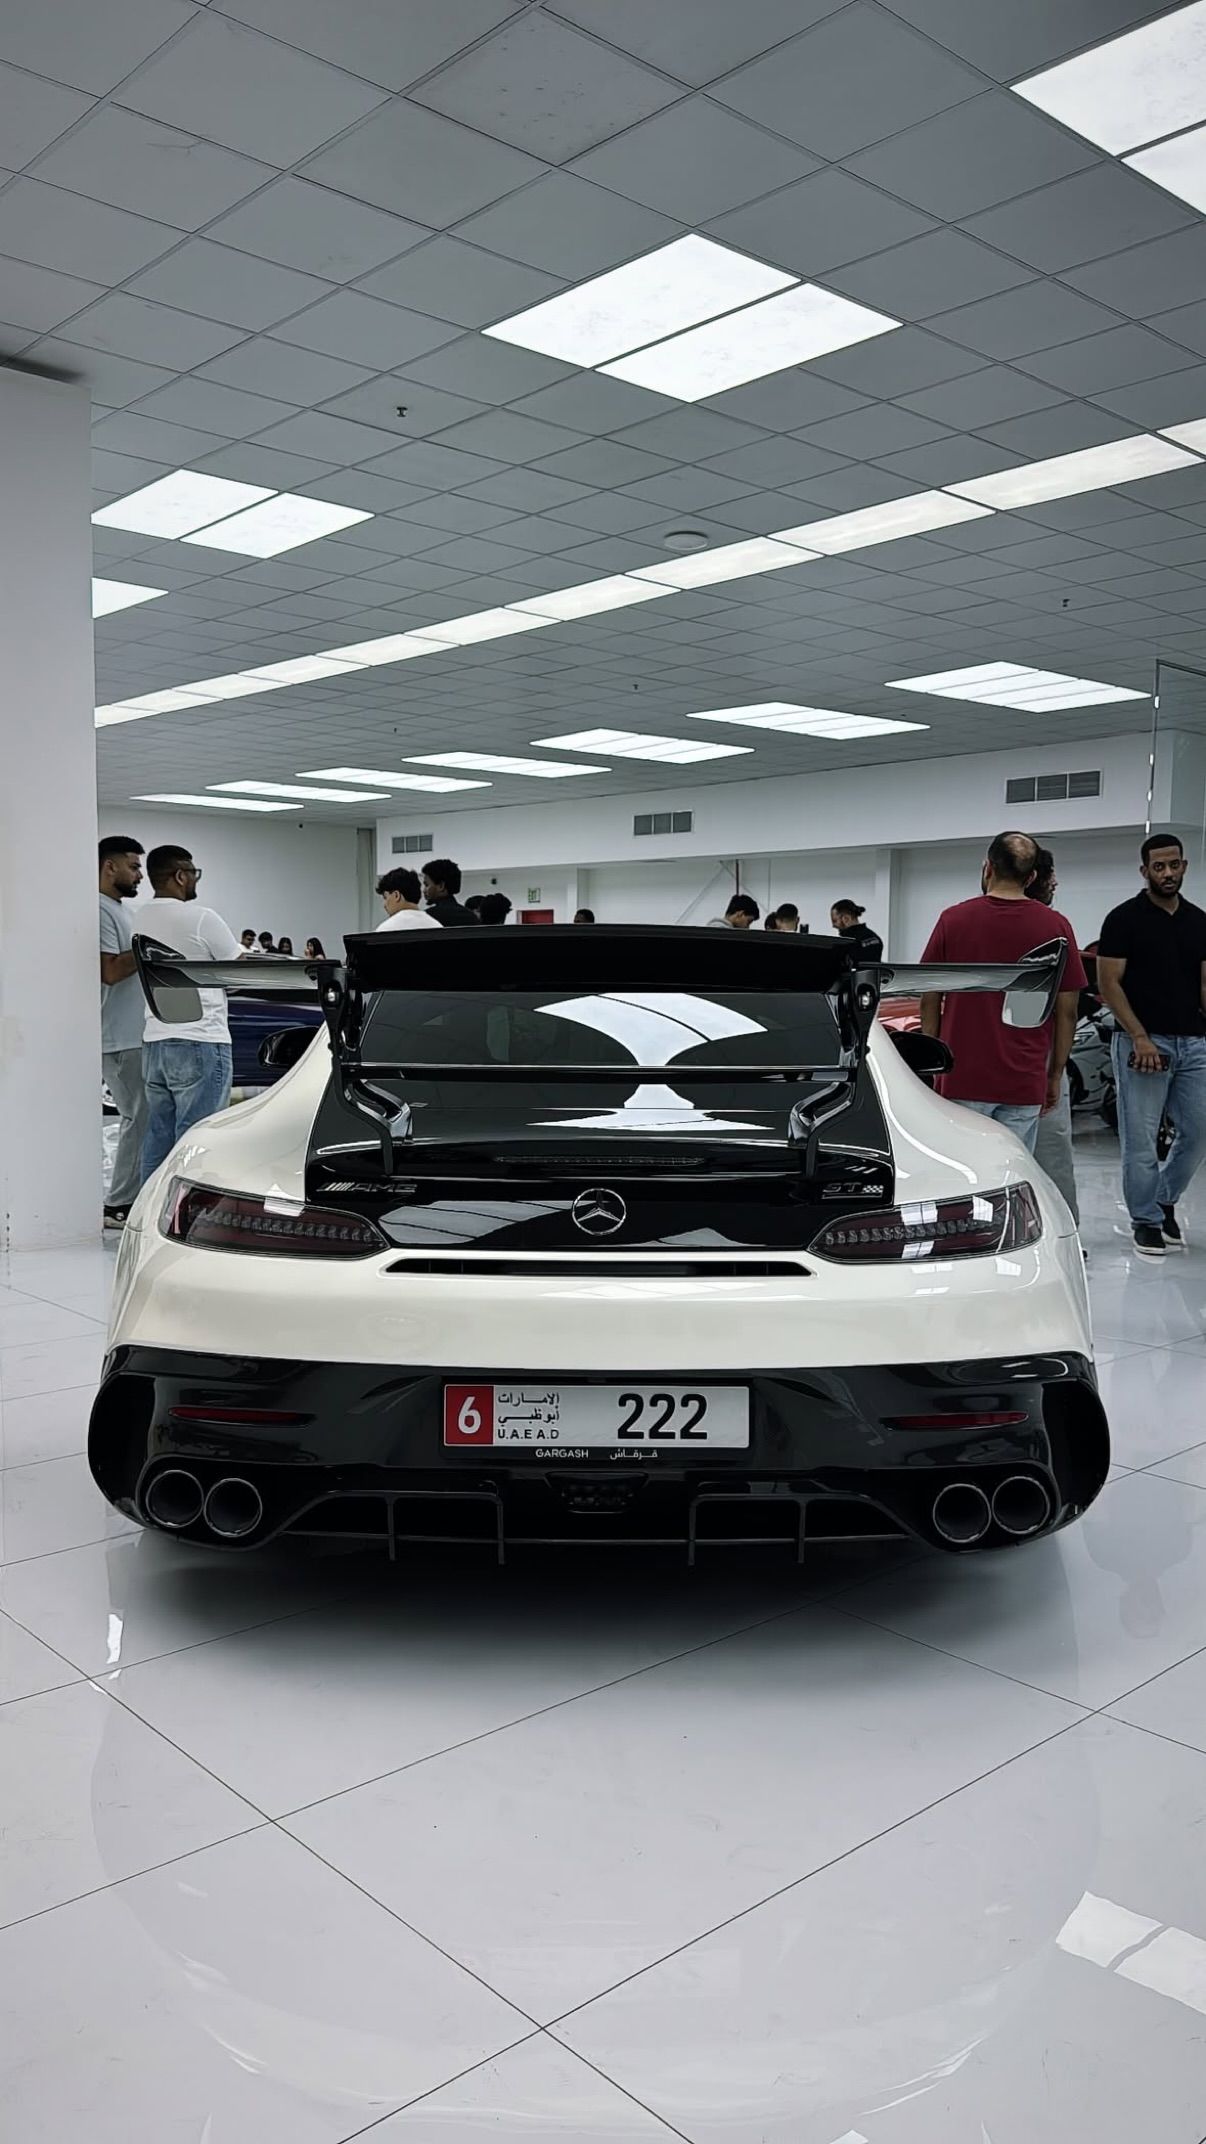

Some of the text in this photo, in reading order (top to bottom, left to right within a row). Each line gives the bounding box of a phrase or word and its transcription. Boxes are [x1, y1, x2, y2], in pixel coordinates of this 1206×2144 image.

[350, 1182, 417, 1193] AMG
[457, 1396, 482, 1434] 6
[617, 1393, 708, 1440] 222
[535, 1449, 589, 1458] GARGASH
